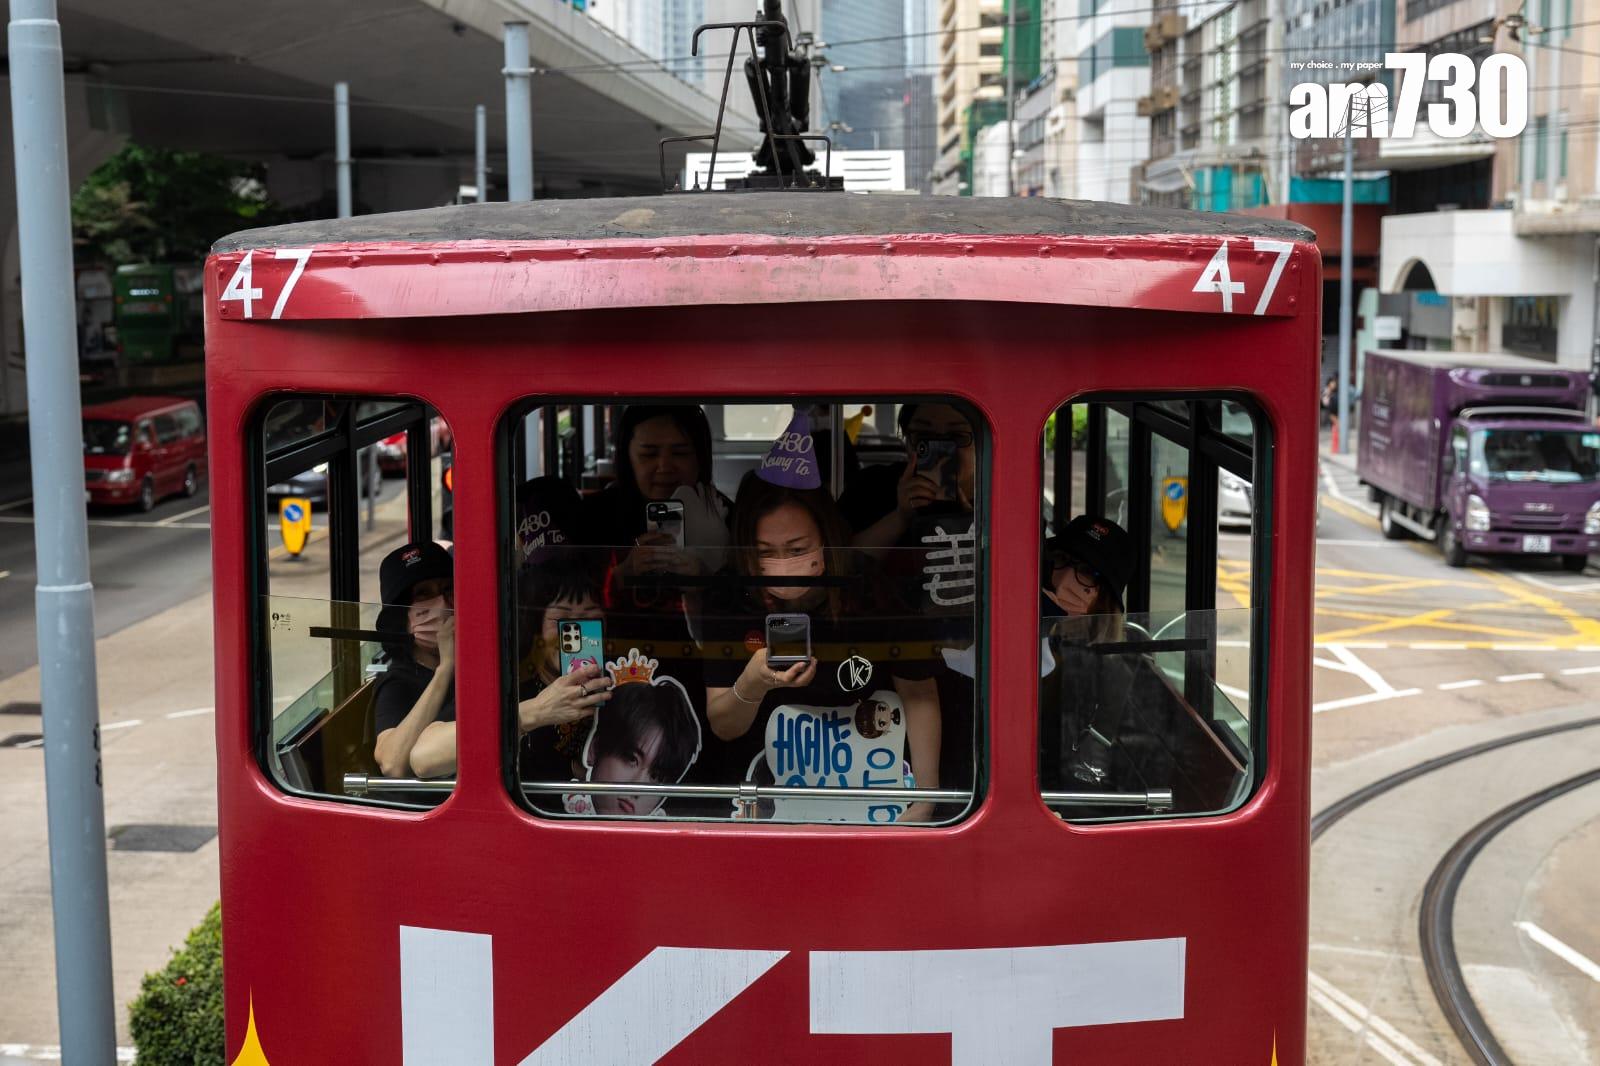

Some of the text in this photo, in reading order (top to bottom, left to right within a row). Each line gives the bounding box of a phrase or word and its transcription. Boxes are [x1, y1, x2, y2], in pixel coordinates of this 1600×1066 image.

[220, 249, 314, 320] 47
[1192, 239, 1295, 316] 47
[795, 457, 811, 476] To
